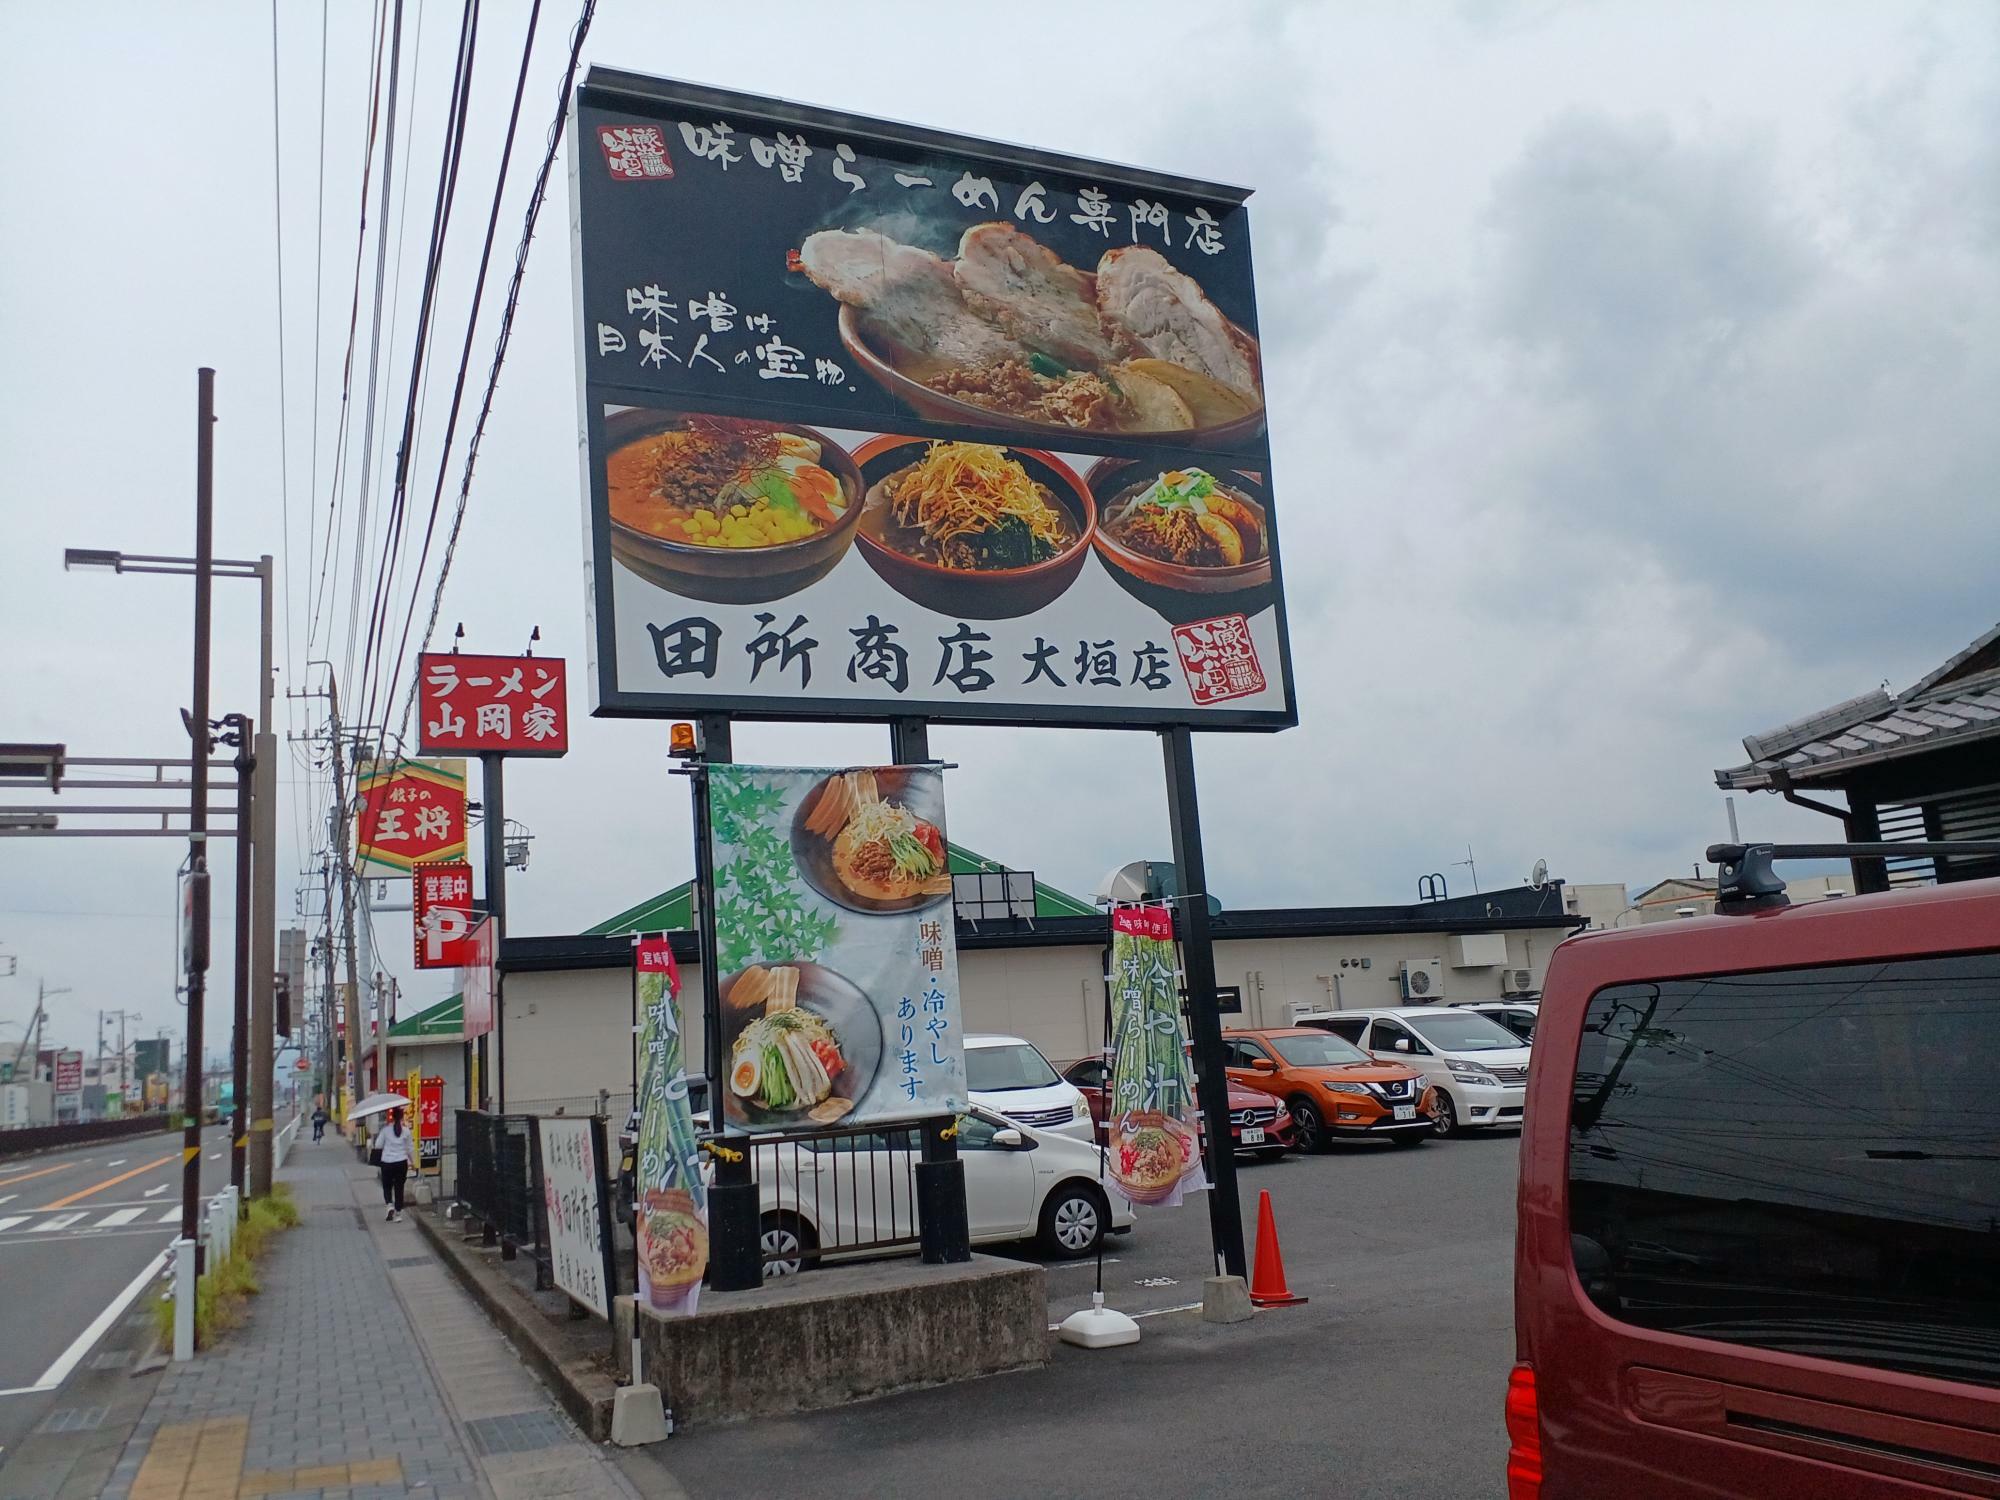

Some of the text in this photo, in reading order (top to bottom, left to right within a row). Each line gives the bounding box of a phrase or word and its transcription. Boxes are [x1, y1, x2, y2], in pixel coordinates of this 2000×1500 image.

[679, 121, 1226, 256] 味噌らーめん専門店
[626, 284, 777, 334] 味噌は
[646, 612, 995, 694] 田所商店
[1020, 637, 1176, 691] 大垣店
[426, 664, 559, 699] ラーメン
[428, 701, 559, 742] 山岡家
[389, 787, 432, 803] 餃子の
[374, 804, 452, 841] 王将
[424, 875, 468, 901] 営業中
[425, 909, 468, 960] P
[897, 996, 924, 1102] あります
[1119, 954, 1143, 1133] 味噌らーめん
[1142, 951, 1178, 1117] 冷や汁
